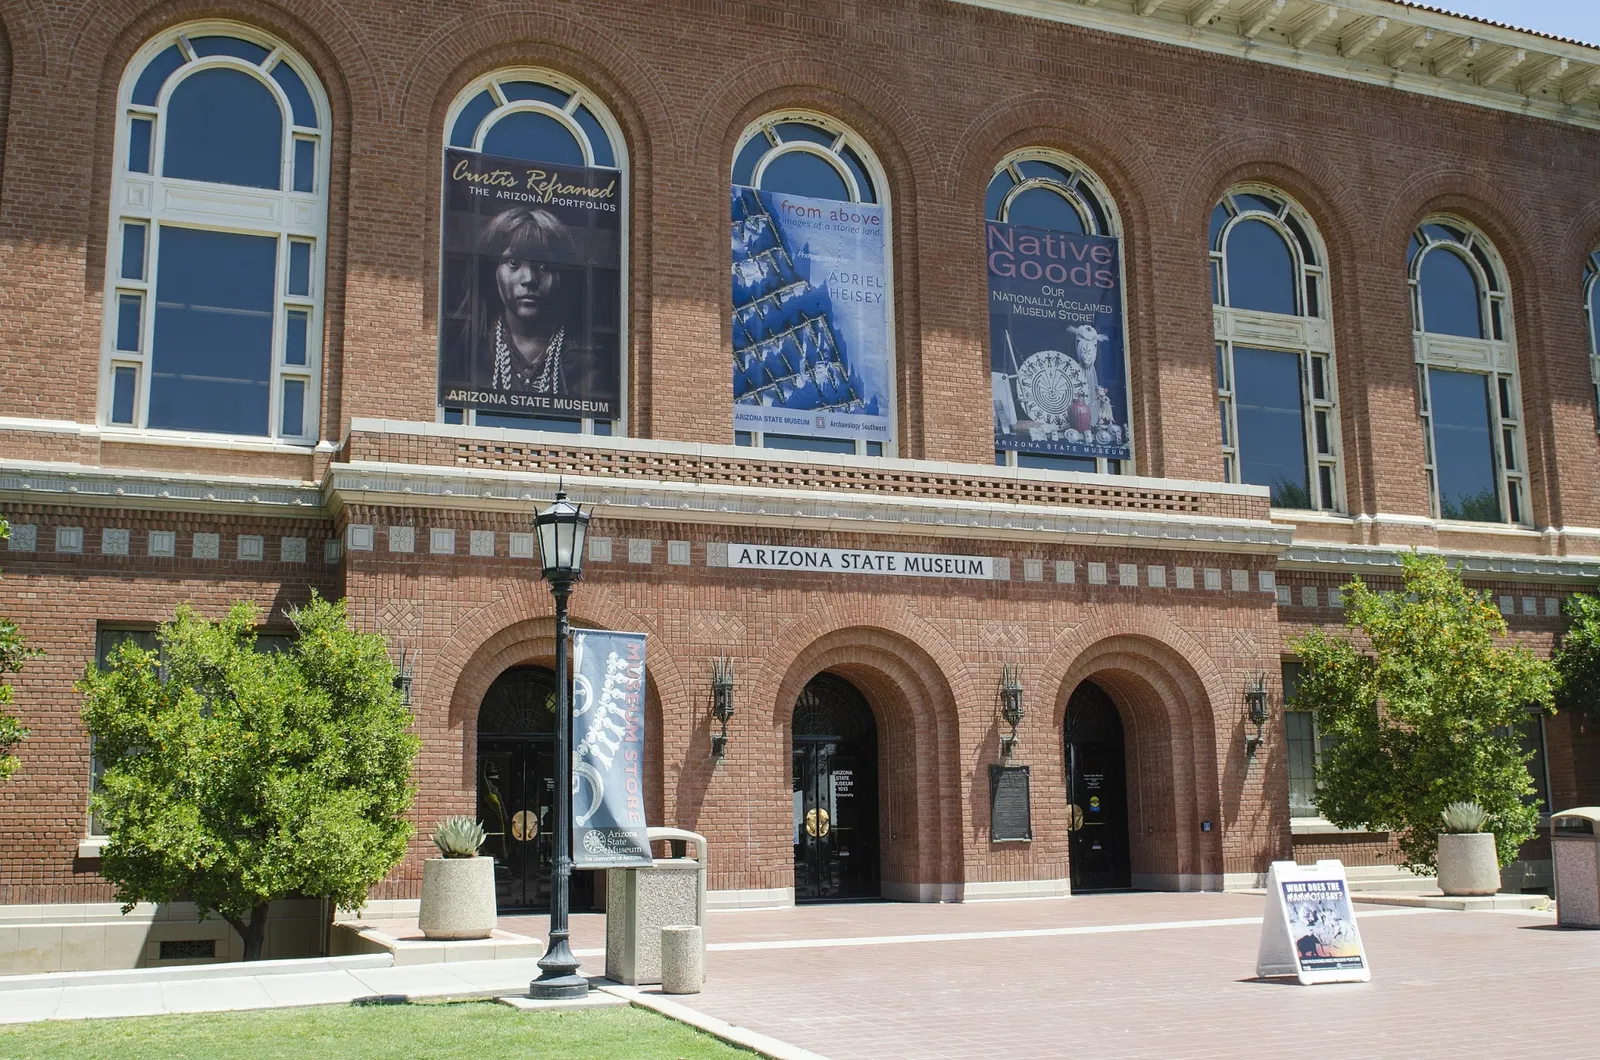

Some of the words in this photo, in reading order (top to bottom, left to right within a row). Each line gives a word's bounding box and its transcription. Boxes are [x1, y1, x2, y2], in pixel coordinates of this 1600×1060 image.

[452, 159, 518, 187] Curtis
[526, 169, 616, 204] Reframed
[469, 186, 490, 196] THE
[496, 190, 543, 204] ARIZONA
[552, 197, 616, 212] PORTFOLIOS
[781, 199, 821, 219] from
[829, 208, 880, 226] above
[782, 218, 811, 228] images
[813, 222, 822, 231] of
[833, 225, 860, 234] storied
[862, 227, 880, 237] land
[987, 225, 1113, 266] Native
[988, 250, 1115, 289] Goods
[828, 272, 883, 288] ADRIEL
[829, 288, 883, 304] HEISEY
[1041, 285, 1065, 298] OUR
[992, 290, 1055, 307] NATIONALLY
[1056, 299, 1113, 314] ACCLAIMED
[1013, 304, 1056, 319] MUSEUM
[1058, 309, 1096, 323] STORE!
[448, 389, 507, 404] ARIZONA
[510, 395, 550, 408] STATE
[554, 399, 609, 413] MUSEUM
[735, 413, 763, 422] ARIZONA
[764, 415, 783, 424] STATE
[784, 417, 810, 426] MUSEUM
[829, 420, 861, 430] Archaeology
[861, 423, 887, 432] Southwest
[994, 439, 1041, 449] ARIZONA
[1046, 443, 1077, 452] STATE
[1084, 446, 1125, 456] MUSEUM
[738, 548, 833, 568] ARIZONA
[840, 553, 897, 571] STATE
[903, 556, 985, 576] MUSEUM
[624, 642, 641, 742] MUSEUM
[623, 750, 641, 824] STORE
[607, 829, 638, 838] Arizona
[607, 837, 627, 846] State
[607, 845, 643, 854] Museum
[1286, 883, 1306, 892] WHAT
[1307, 882, 1326, 891] DOES
[1326, 882, 1340, 891] THE
[1326, 891, 1343, 900] SAY?
